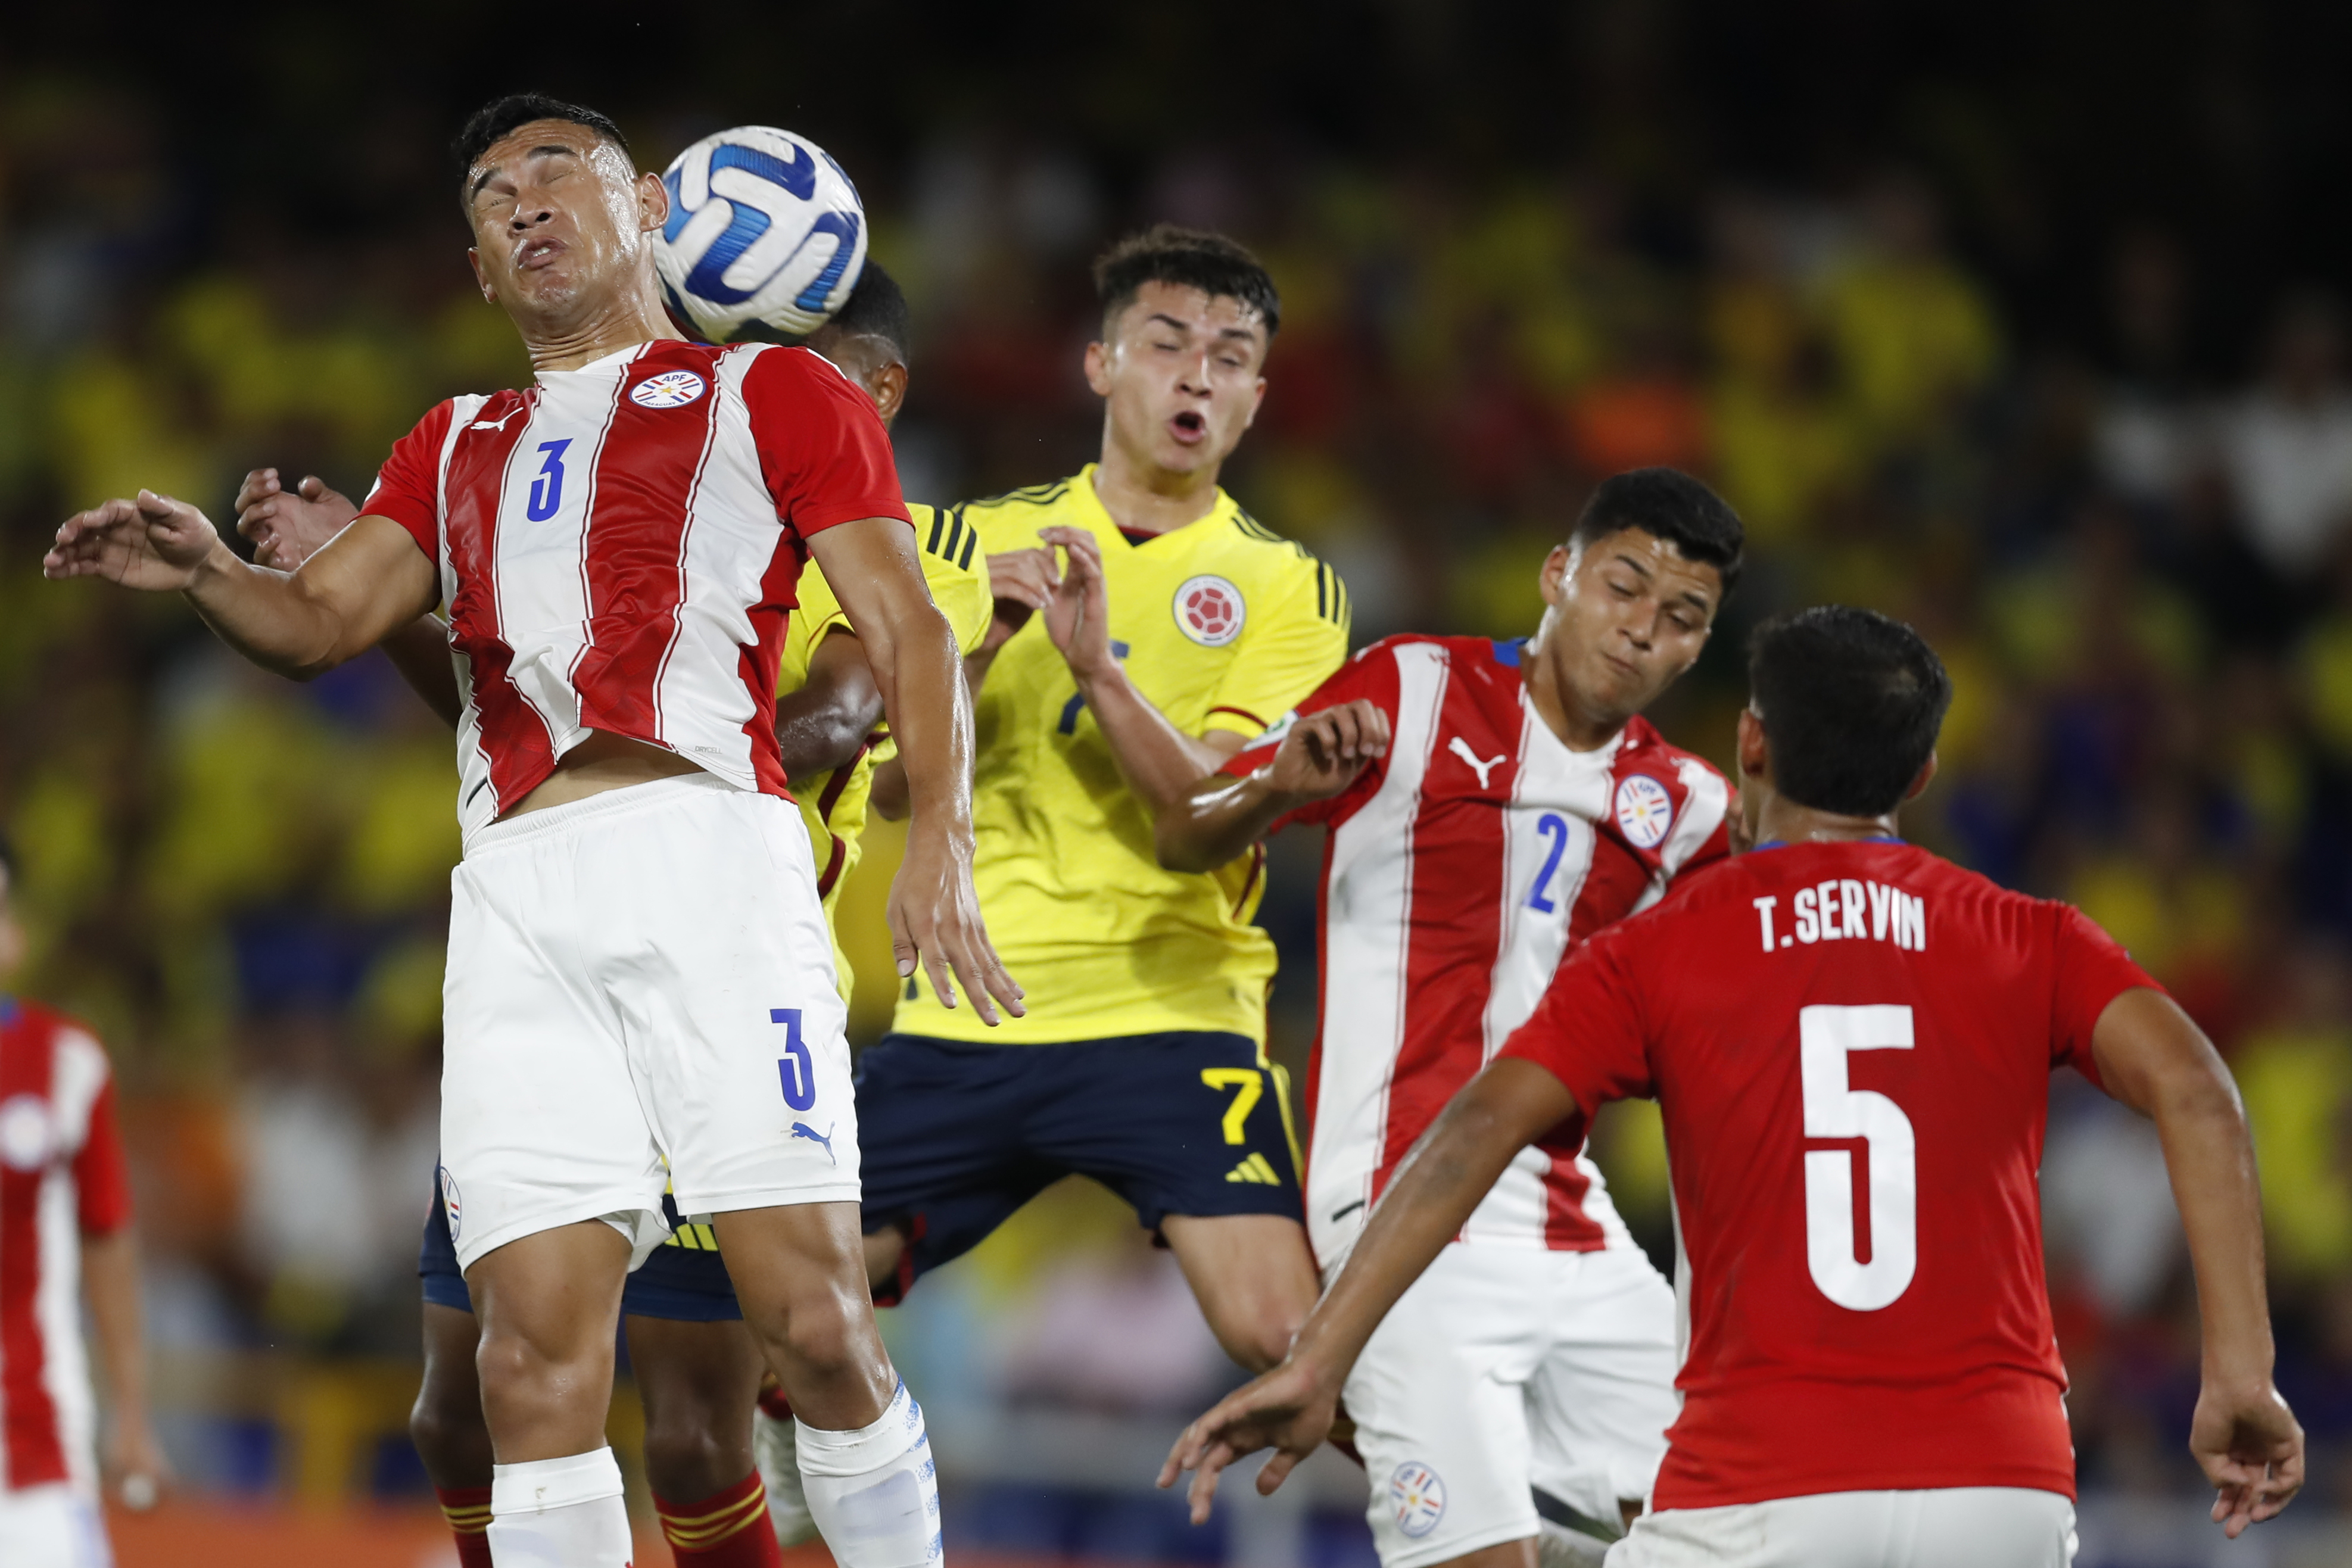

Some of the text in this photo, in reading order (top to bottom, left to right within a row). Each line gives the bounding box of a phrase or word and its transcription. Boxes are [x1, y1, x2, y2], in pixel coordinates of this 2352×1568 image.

[527, 438, 574, 522] 3
[1522, 813, 1569, 914] 2
[1753, 879, 1926, 952] T.SERVIN
[770, 1009, 815, 1111] 3
[1200, 1067, 1263, 1145] 7
[1799, 1003, 1916, 1311] 5
